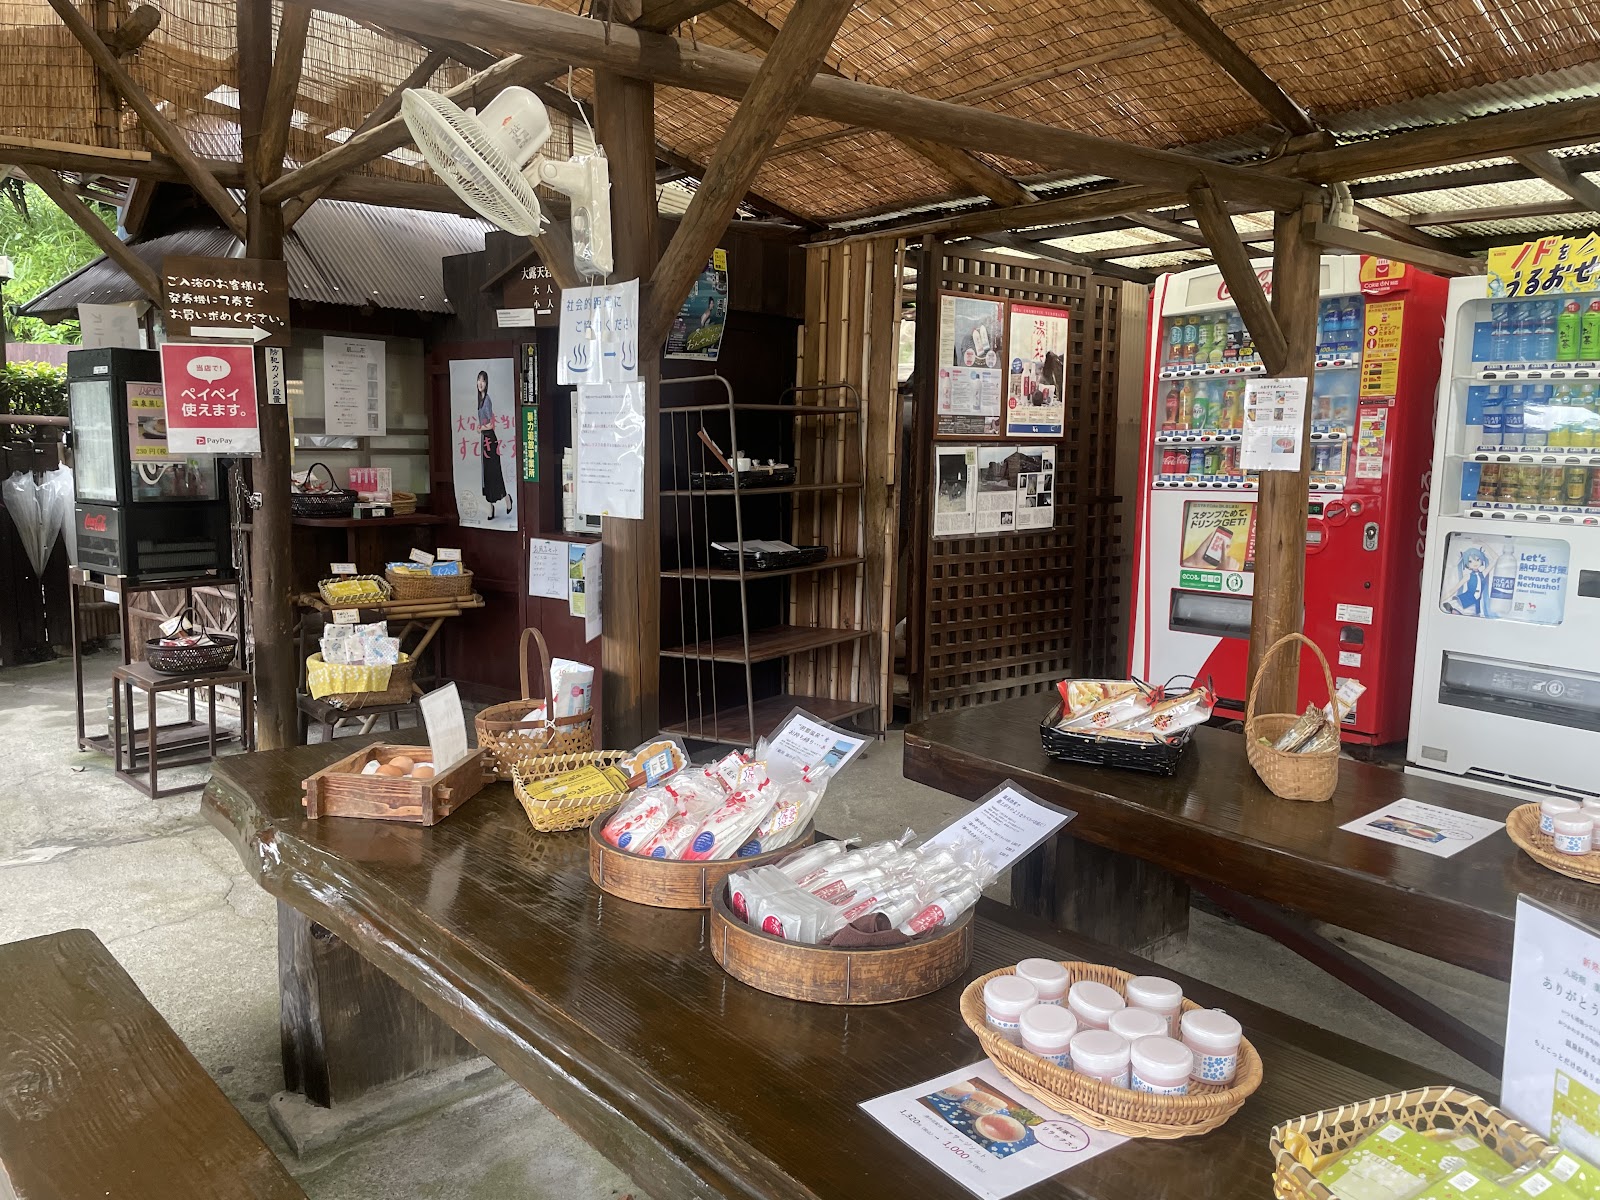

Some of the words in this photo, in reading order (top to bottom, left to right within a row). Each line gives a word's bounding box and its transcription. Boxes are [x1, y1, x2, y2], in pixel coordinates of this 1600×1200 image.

[1510, 239, 1570, 270] ノドを
[167, 275, 269, 294] ご入浴のお客様は、
[168, 291, 255, 308] 発券機にて券を
[567, 295, 621, 312] 社会的距に
[169, 308, 285, 326] お買い求めください。
[196, 364, 222, 373] 当店で!
[269, 348, 282, 404] 防犯カメラ設置
[180, 387, 240, 402] ペイペイ
[131, 399, 163, 408] 温泉蒸し
[180, 403, 248, 418] 使えます。
[206, 437, 233, 446] PayPay
[1191, 509, 1248, 520] スタンプためて、
[1190, 518, 1247, 529] ドリンクGET!
[1517, 581, 1560, 591] Nechusho!
[1518, 574, 1549, 583] Beware
[1583, 957, 1600, 974] 新発
[1542, 976, 1599, 1016] ありがとう
[942, 1140, 970, 1159] 1,000
